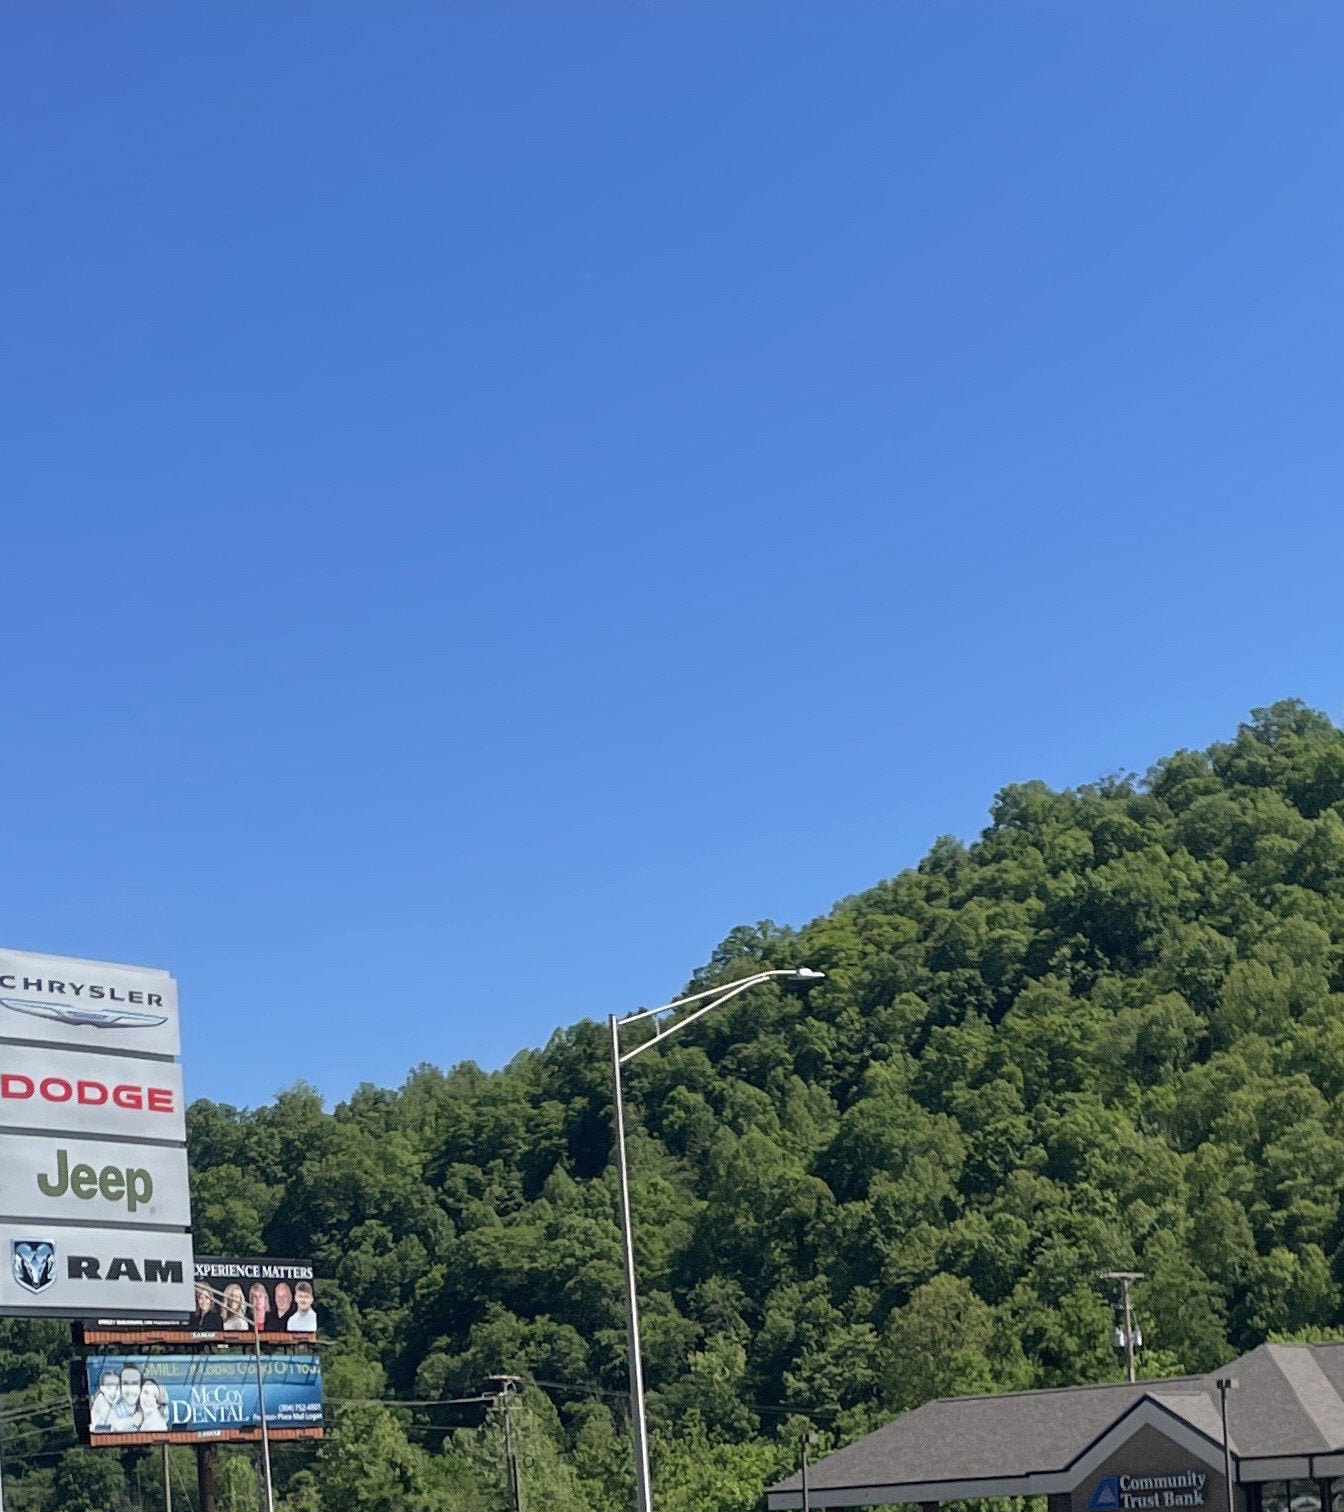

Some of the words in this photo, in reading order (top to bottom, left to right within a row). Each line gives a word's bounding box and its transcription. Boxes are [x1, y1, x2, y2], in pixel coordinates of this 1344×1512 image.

[0, 1073, 174, 1113] DODGE
[37, 1149, 154, 1212] Jeep
[66, 1255, 184, 1284] RAM
[194, 1263, 260, 1278] XPERIENCE
[262, 1265, 313, 1279] MATTERS
[171, 1399, 249, 1424] DENTAL
[1119, 1470, 1206, 1491] Community
[1120, 1492, 1161, 1509] Trust
[1163, 1489, 1205, 1507] Bank
